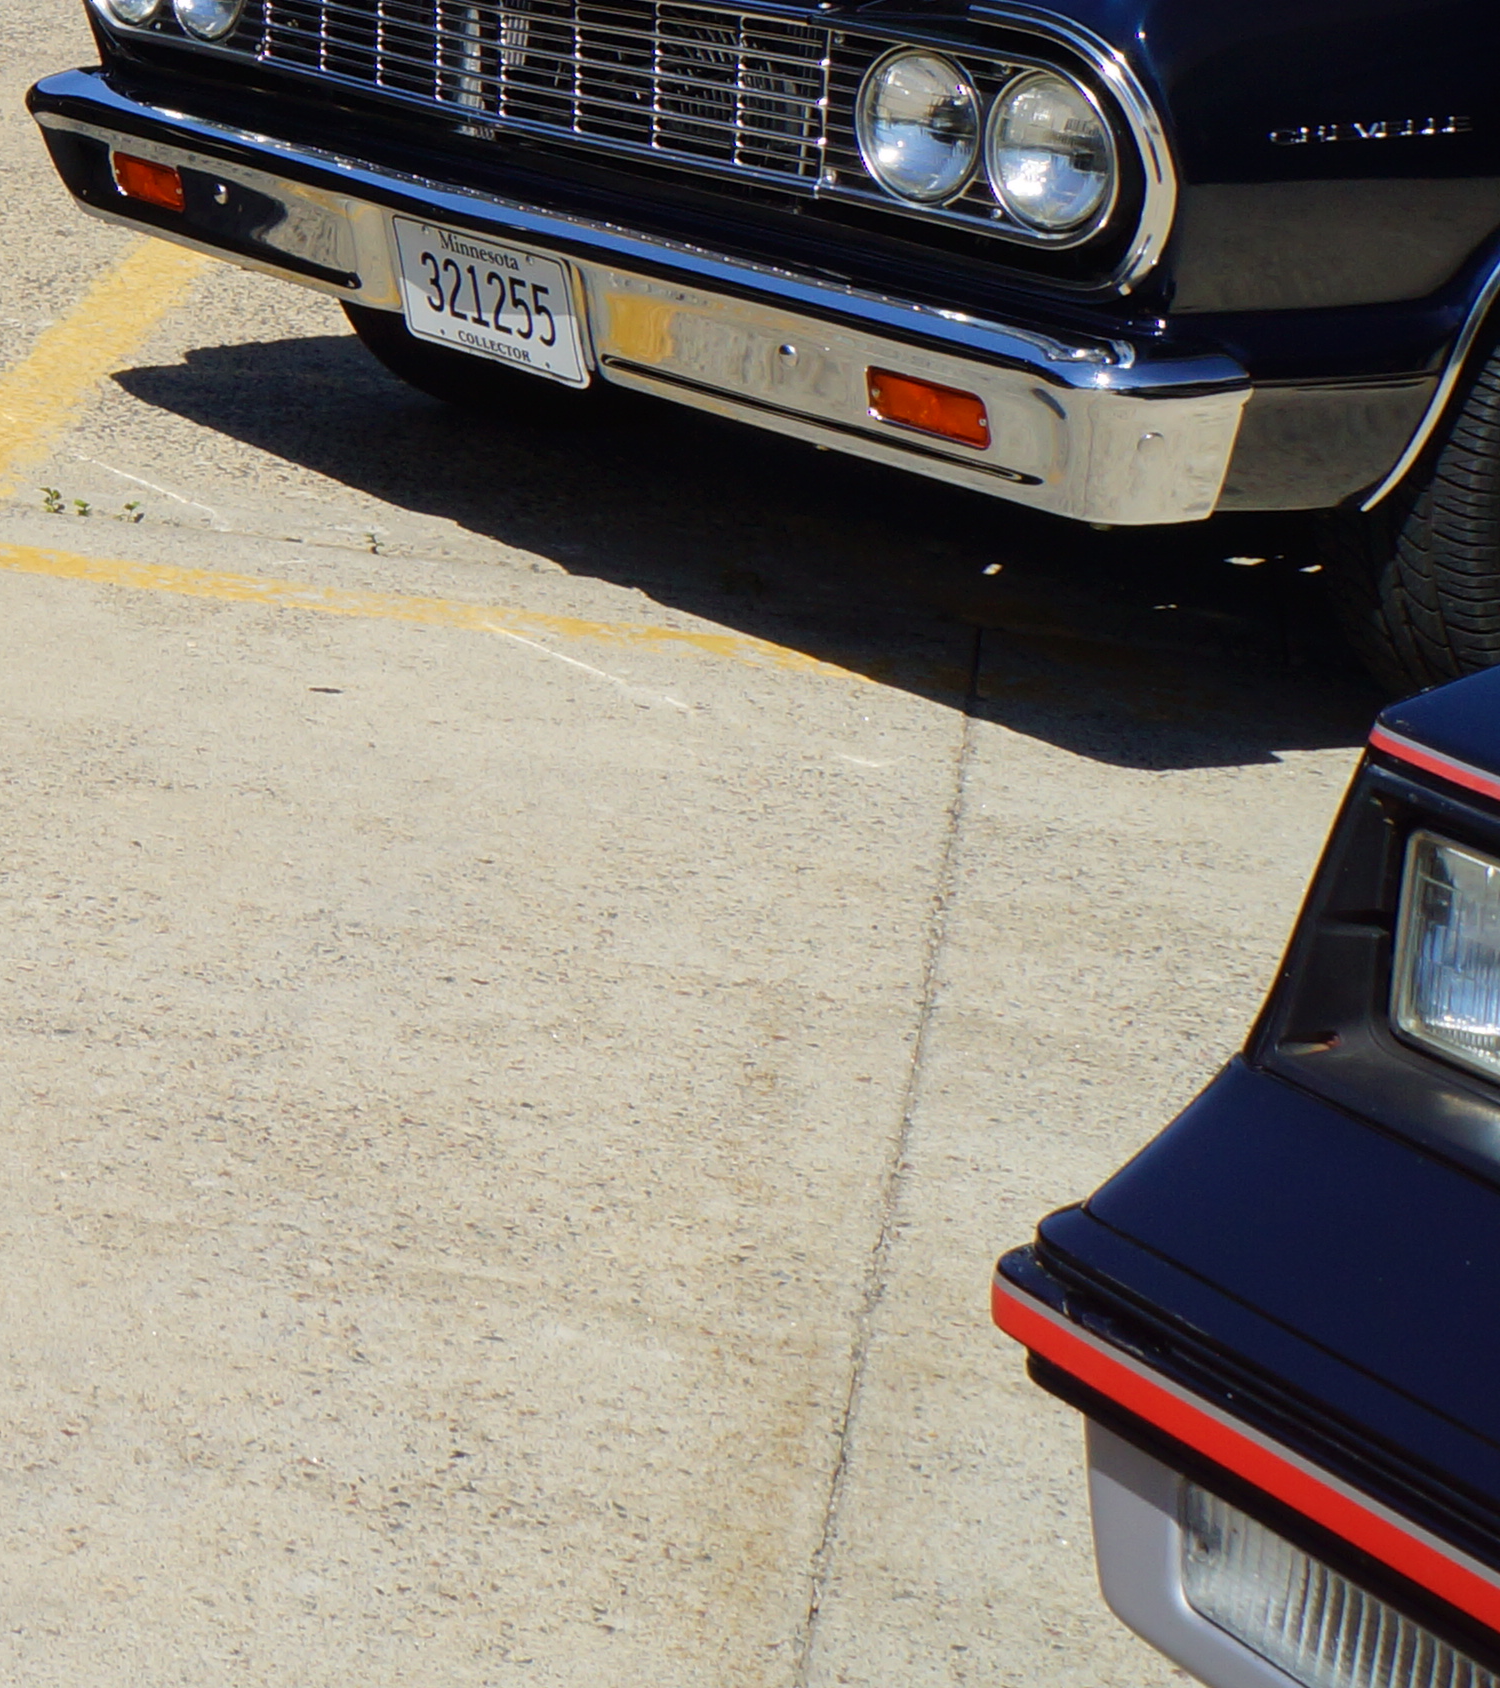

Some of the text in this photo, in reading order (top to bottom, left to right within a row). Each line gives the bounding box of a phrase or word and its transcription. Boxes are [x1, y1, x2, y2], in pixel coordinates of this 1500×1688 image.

[437, 230, 520, 271] Minnesota
[420, 251, 557, 347] 321255
[457, 330, 532, 363] COLLECTOR
